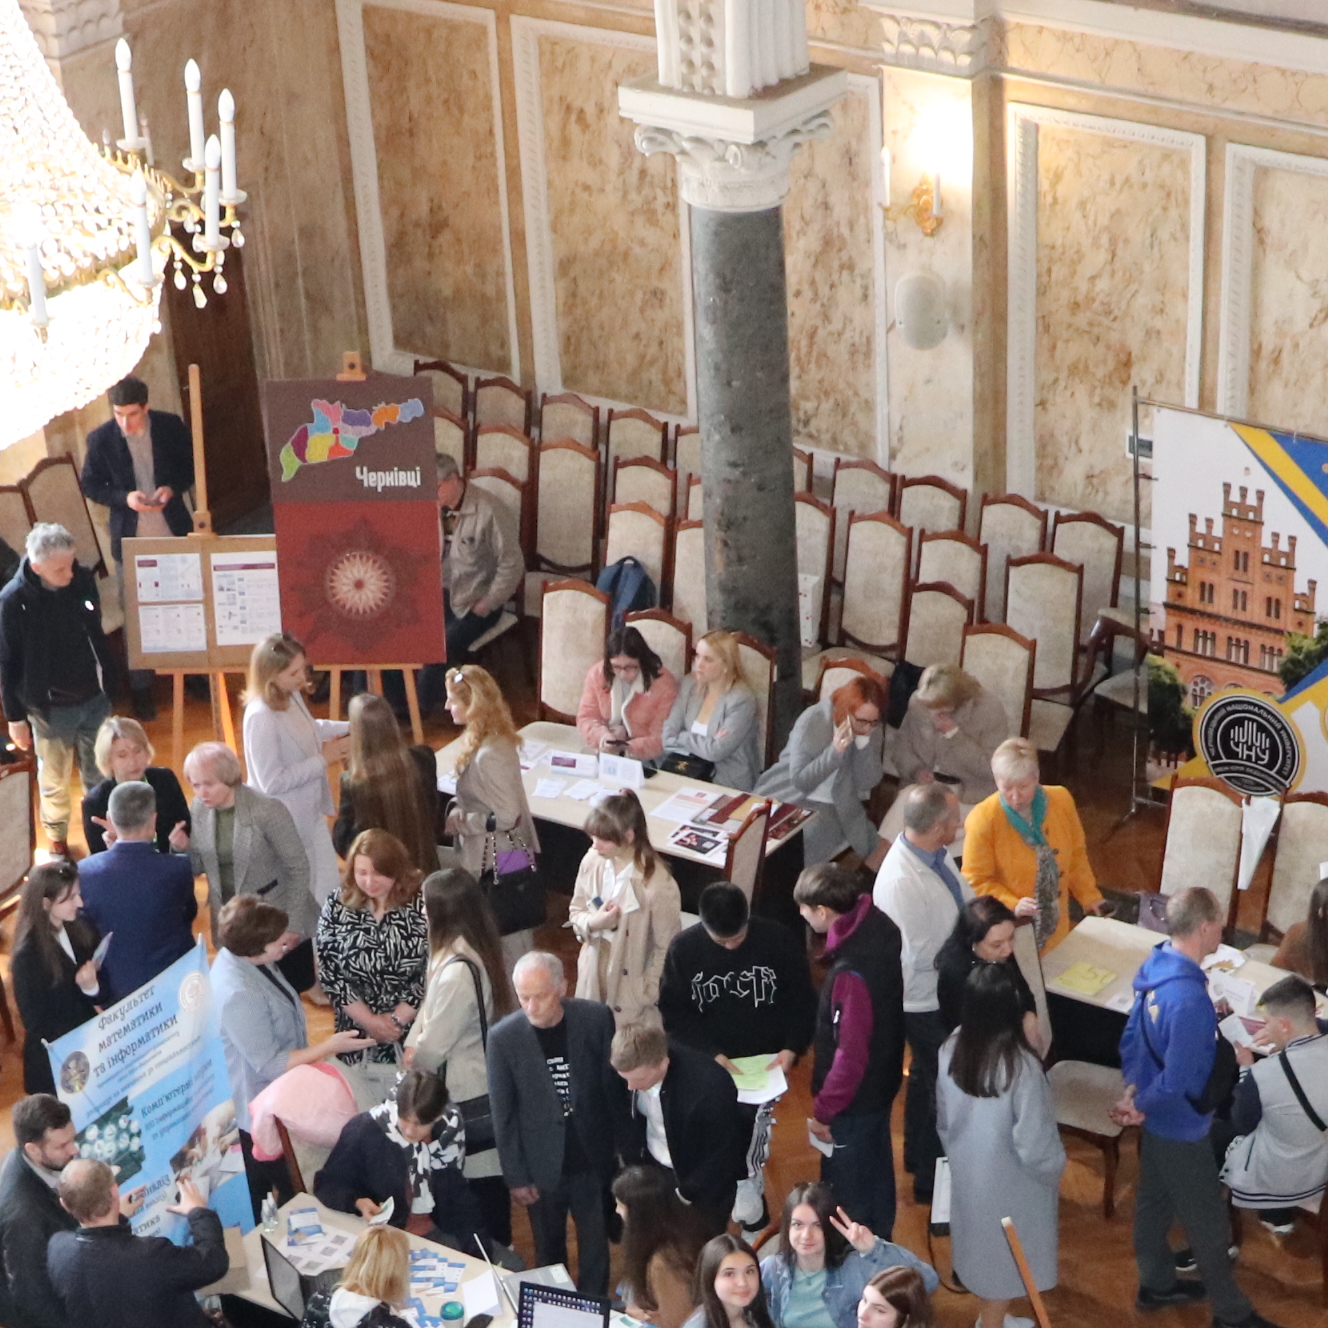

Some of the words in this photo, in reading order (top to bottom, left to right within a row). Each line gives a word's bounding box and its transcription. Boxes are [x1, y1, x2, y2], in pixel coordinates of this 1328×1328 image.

[355, 466, 422, 492] Чернівці
[97, 985, 156, 1031] Факультет
[98, 1001, 163, 1053] математики
[92, 1066, 106, 1078] та
[106, 1013, 178, 1072] інформатики
